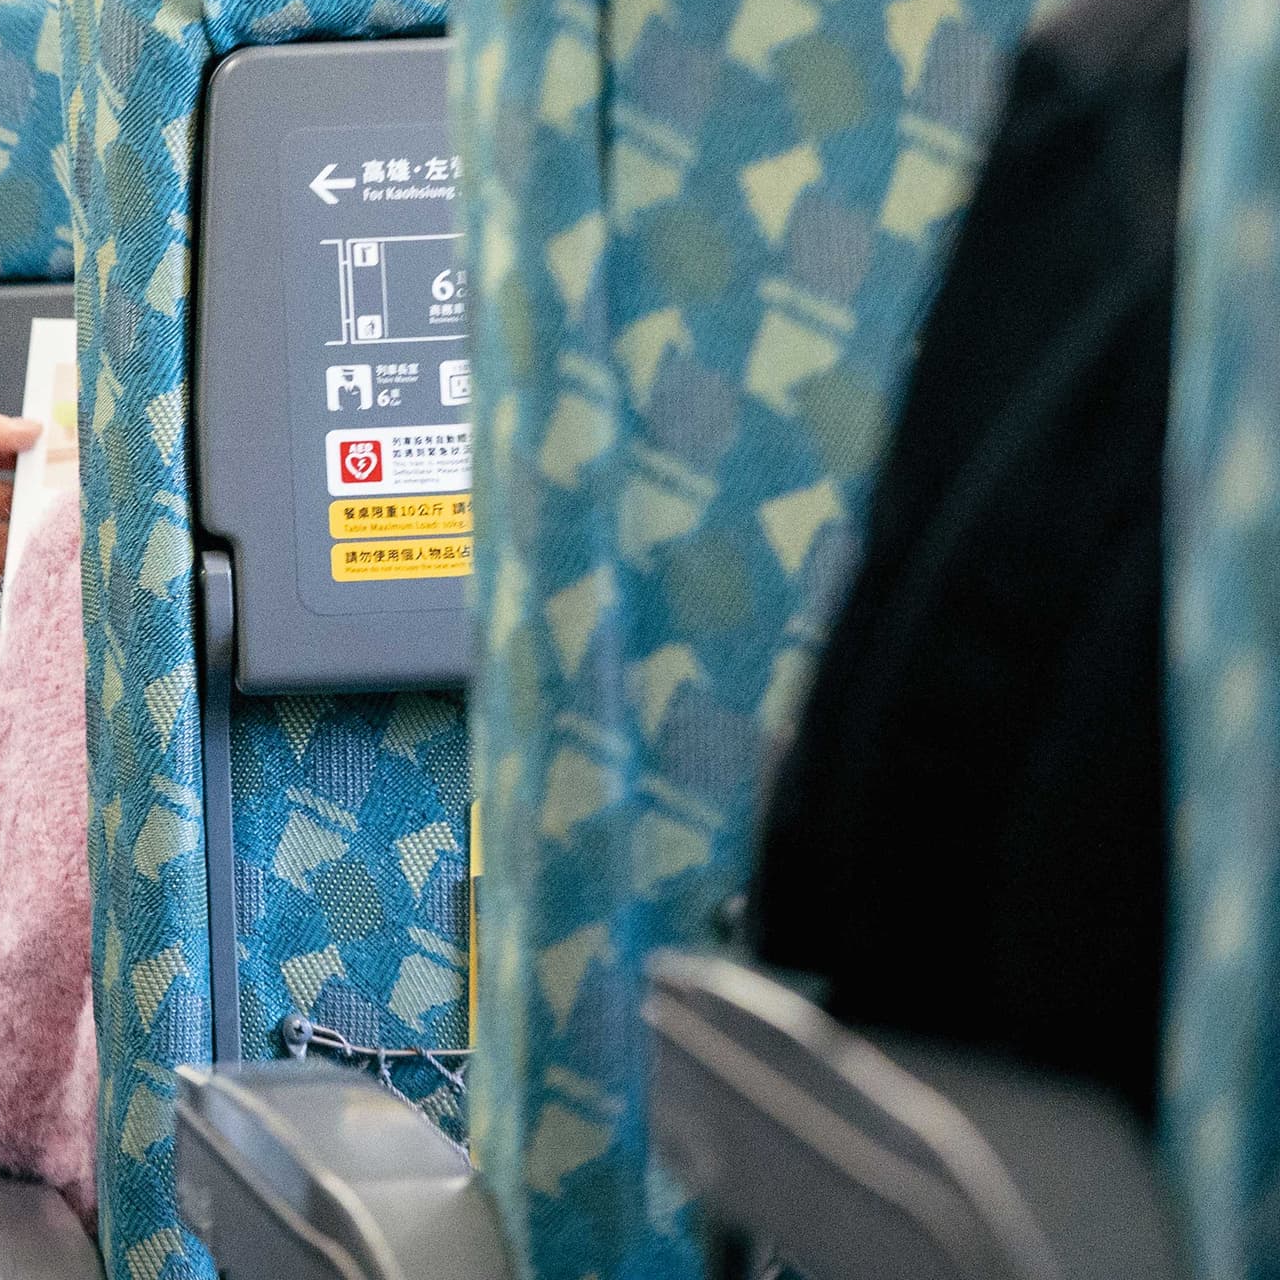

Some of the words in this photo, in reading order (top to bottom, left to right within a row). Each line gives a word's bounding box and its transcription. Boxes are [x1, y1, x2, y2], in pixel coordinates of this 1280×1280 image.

[363, 187, 383, 201] For
[385, 185, 456, 201] Kaohsiung
[431, 268, 454, 301] 6
[377, 388, 390, 407] 6
[348, 442, 374, 454] AED
[344, 502, 444, 520] 餐桌限重10公斤
